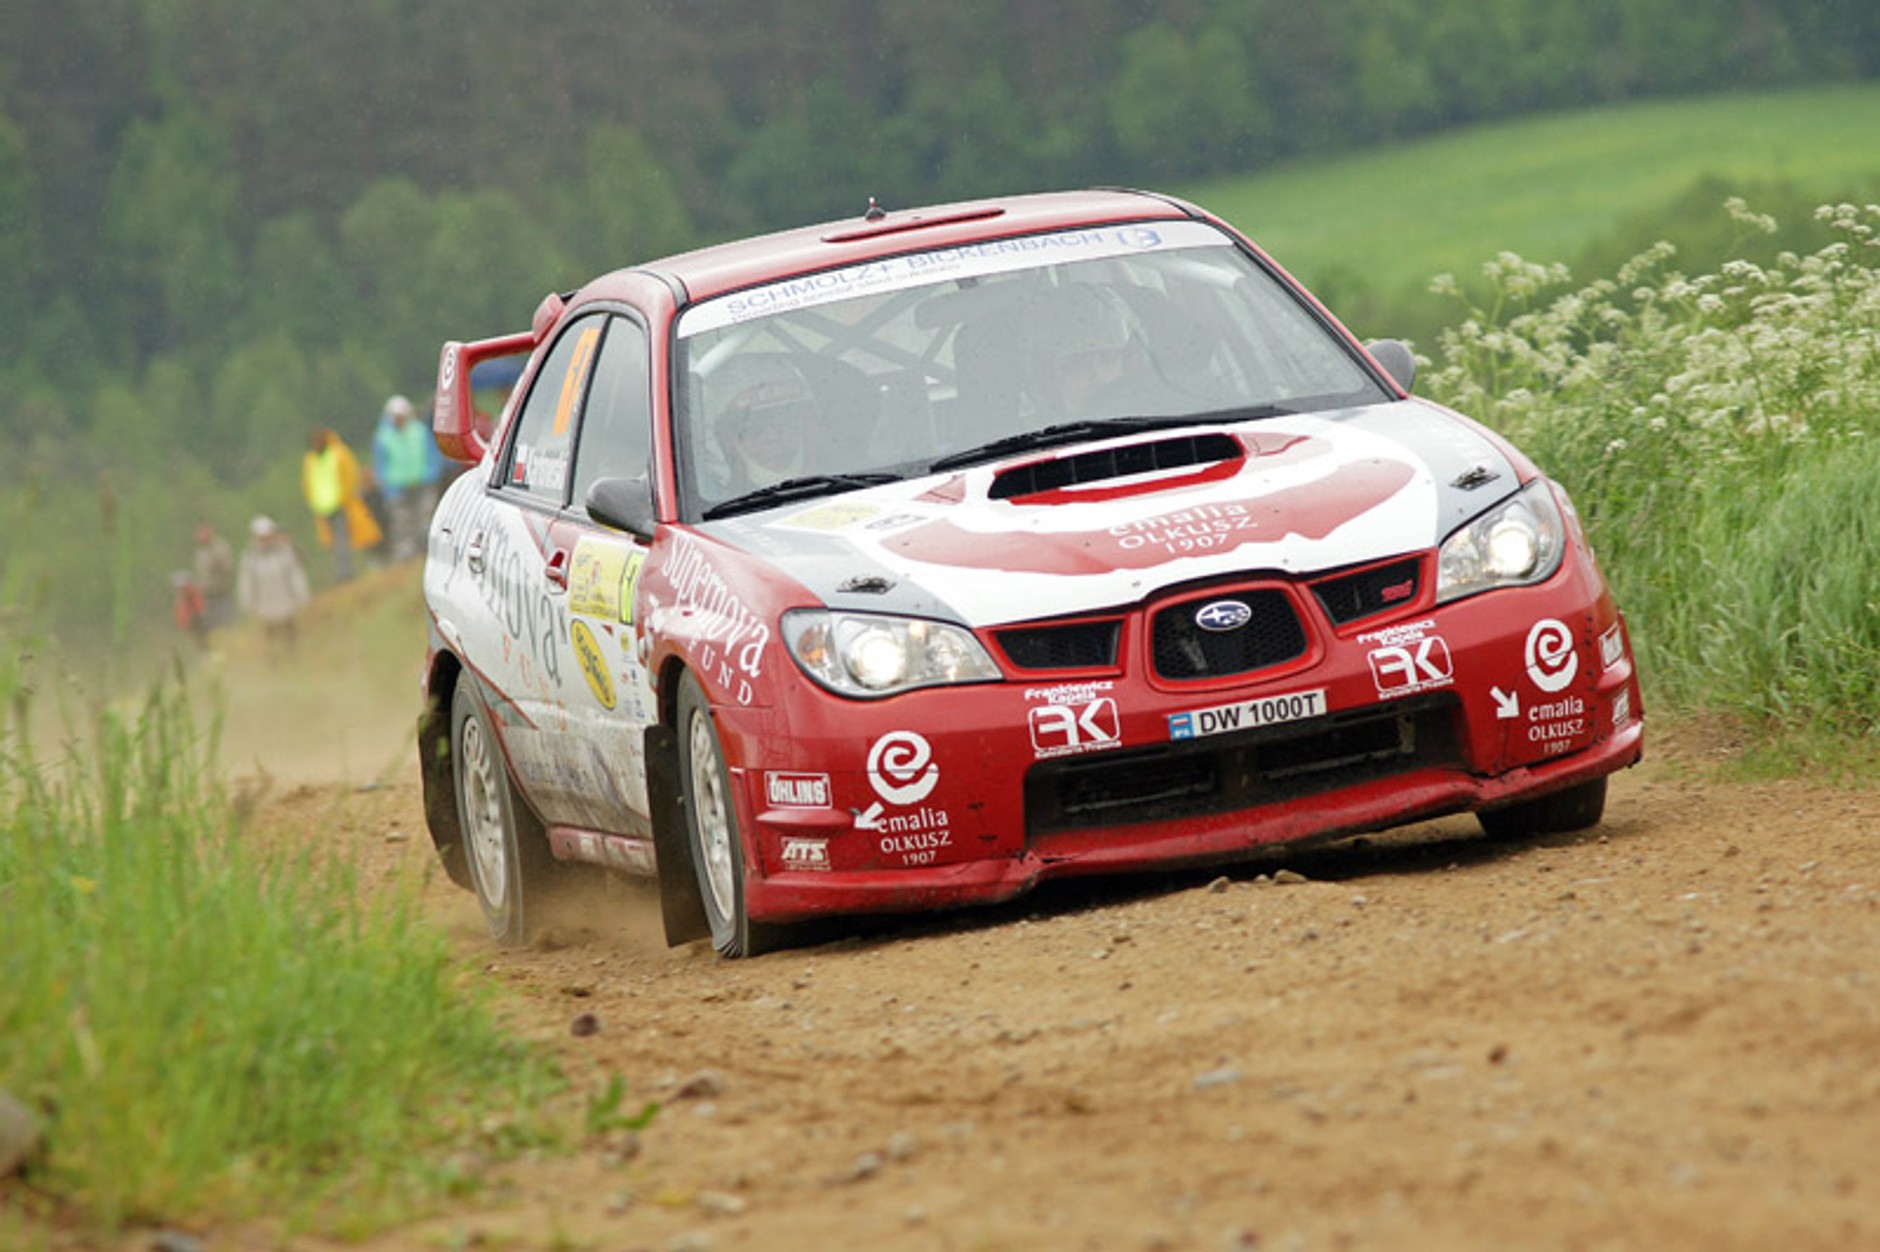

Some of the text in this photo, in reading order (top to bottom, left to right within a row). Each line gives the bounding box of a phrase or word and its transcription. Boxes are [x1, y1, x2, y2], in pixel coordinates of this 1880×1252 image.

[907, 232, 1104, 269] BICKENBACH
[1118, 516, 1259, 549] OLKUSZ
[1165, 533, 1227, 554] 1907
[1199, 693, 1318, 734] DW 1000T
[1528, 695, 1584, 721] emalia
[1528, 719, 1584, 741] OLKUSZ
[878, 807, 948, 833] emalia
[880, 829, 952, 854] OLKUSZ
[902, 850, 937, 866] 1907
